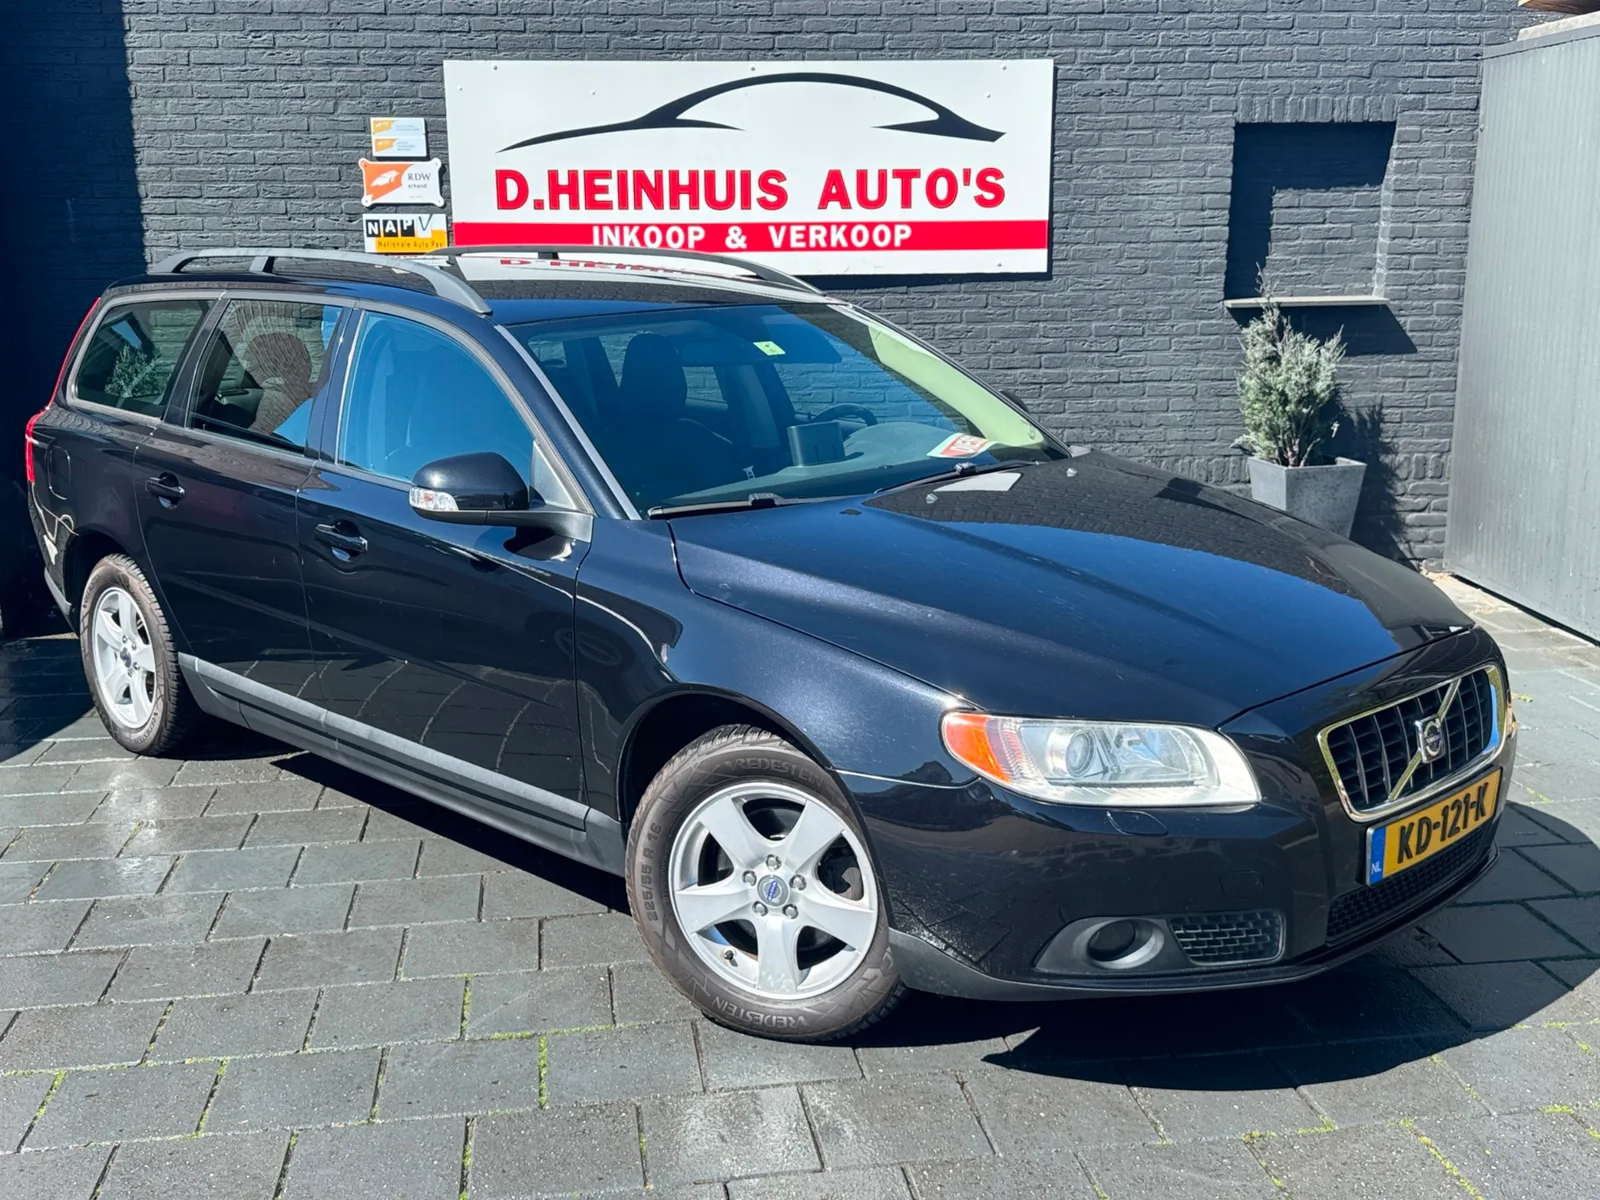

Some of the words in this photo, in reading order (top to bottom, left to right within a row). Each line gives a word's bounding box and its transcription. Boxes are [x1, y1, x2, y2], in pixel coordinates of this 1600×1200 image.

[408, 172, 431, 181] RDW
[495, 169, 788, 210] D.HEINHUIS
[817, 168, 1005, 209] AUTO'S
[378, 240, 411, 249] Nationale
[413, 240, 429, 249] Auto
[592, 225, 705, 248] INKOOP
[725, 225, 747, 249] &
[768, 224, 912, 248] VERKOOP
[647, 822, 662, 842] 16
[1397, 782, 1490, 864] KD-121-K
[1371, 861, 1382, 876] NL
[641, 863, 659, 922] 225/55
[712, 996, 810, 1029] VREDESTEIN
